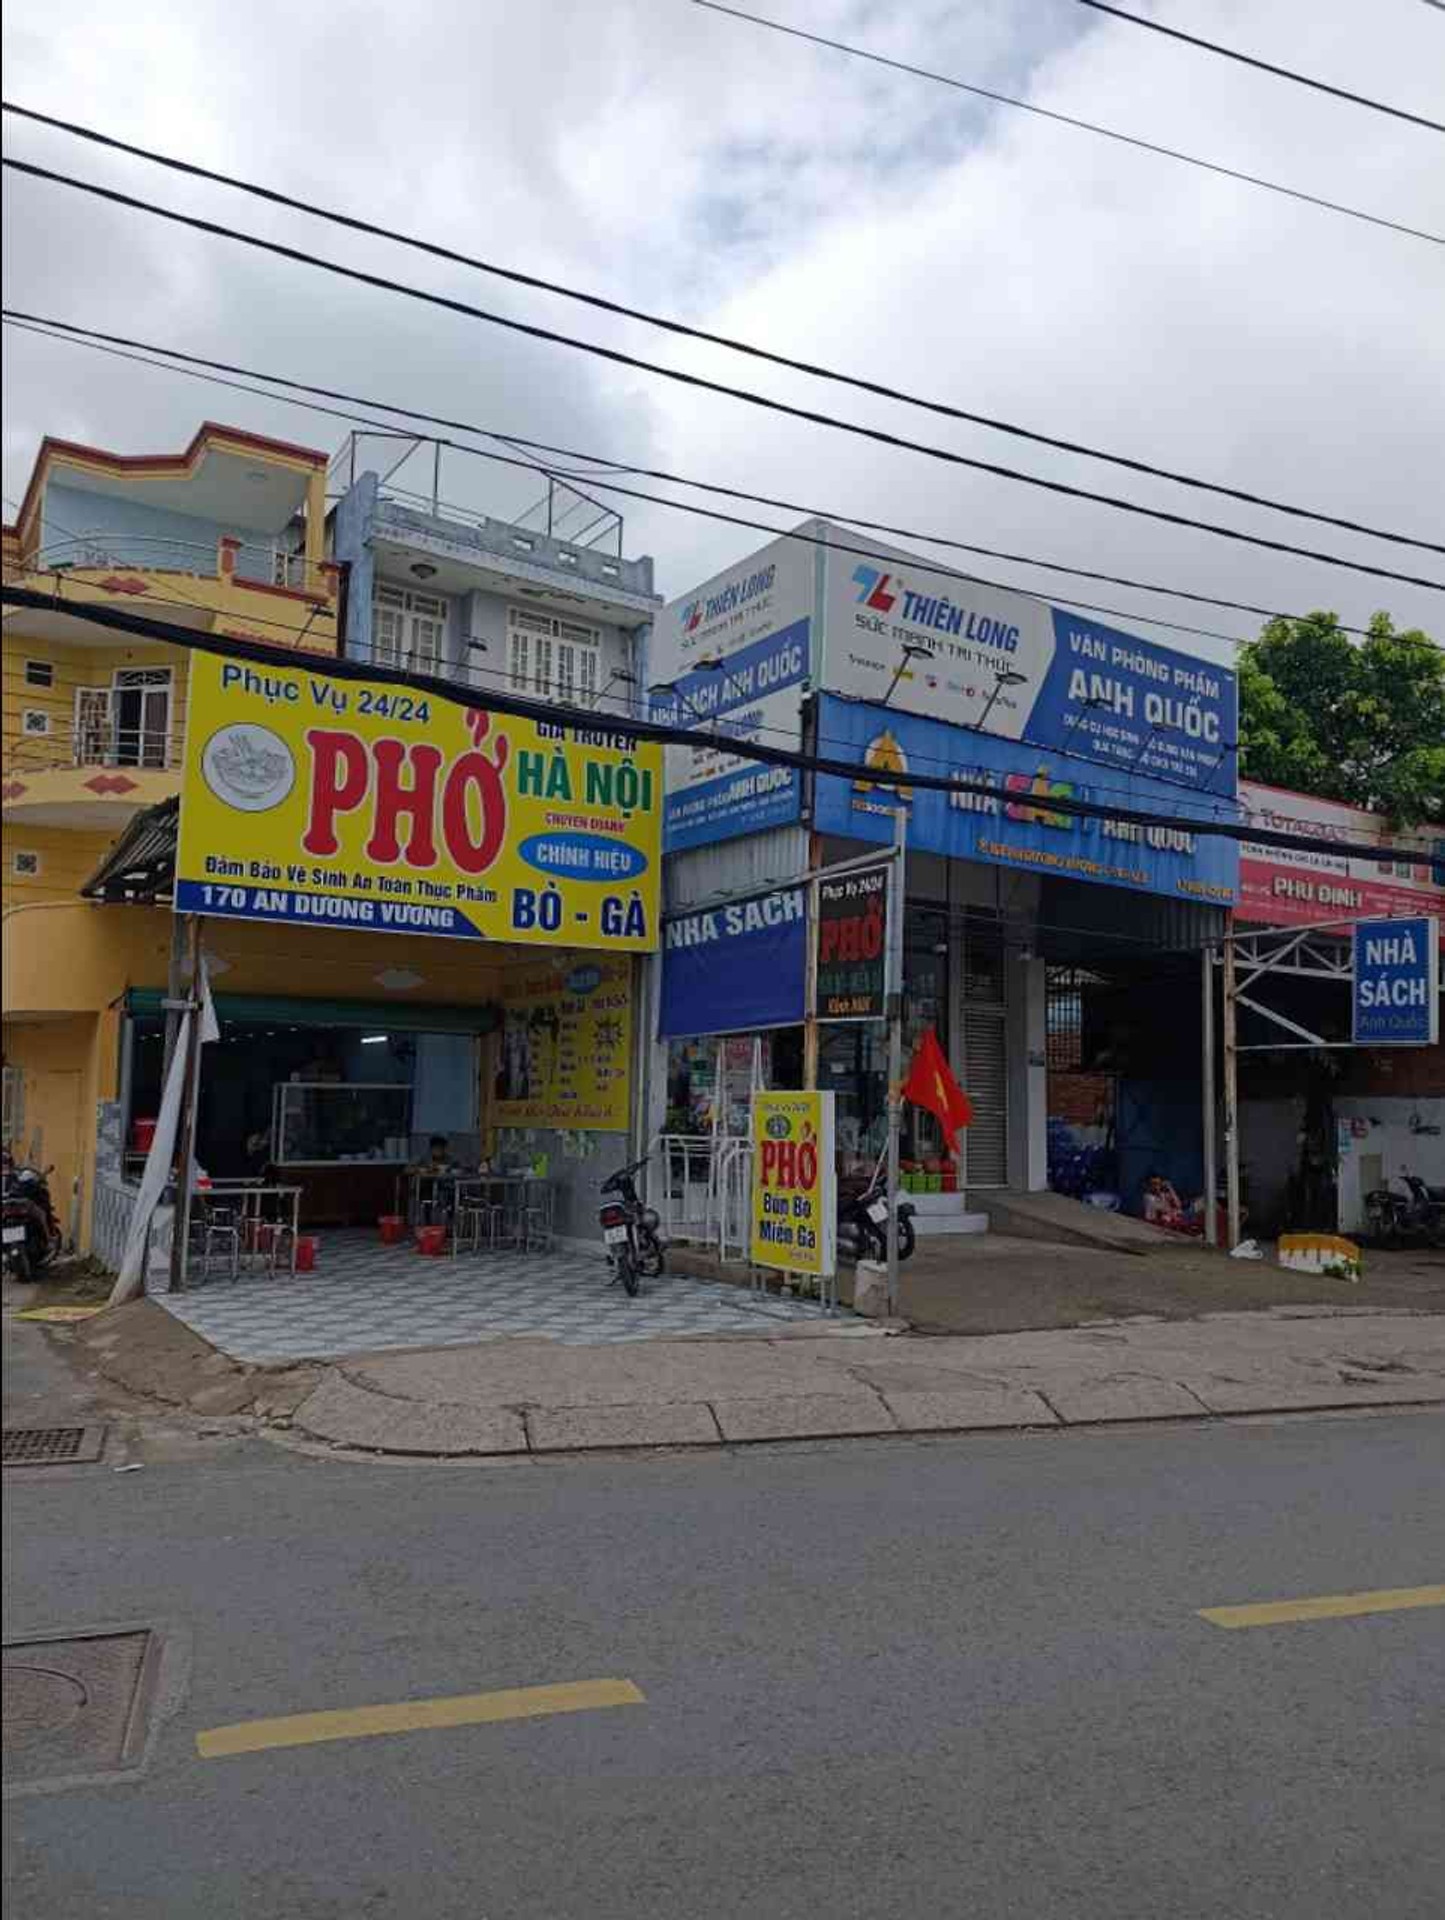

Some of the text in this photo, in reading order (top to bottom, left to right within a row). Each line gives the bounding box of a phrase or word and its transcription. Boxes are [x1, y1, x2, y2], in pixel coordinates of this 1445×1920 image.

[902, 589, 1020, 654] THIÊN LONG
[223, 664, 431, 724] Phục Vụ 24/24
[757, 642, 802, 688] QUỐC
[1069, 631, 1220, 699] VĂN PHÒNG PHẨM
[1068, 669, 1135, 719] ANH
[1144, 692, 1220, 744] QUỐC
[303, 708, 508, 875] PHỞ
[517, 745, 572, 801] HÀ
[586, 757, 652, 819] NỘI
[312, 867, 347, 888] Sinh
[353, 873, 373, 890] An
[537, 840, 633, 876] CHÍNH HIỆU
[201, 885, 455, 928] 170 AN DƯƠNG VƯƠNG
[512, 881, 562, 932] BÒ
[600, 890, 647, 938] GÀ
[1366, 929, 1417, 965] NHÀ
[1359, 972, 1426, 1007] SÁCH
[760, 1120, 818, 1190] PHỞ
